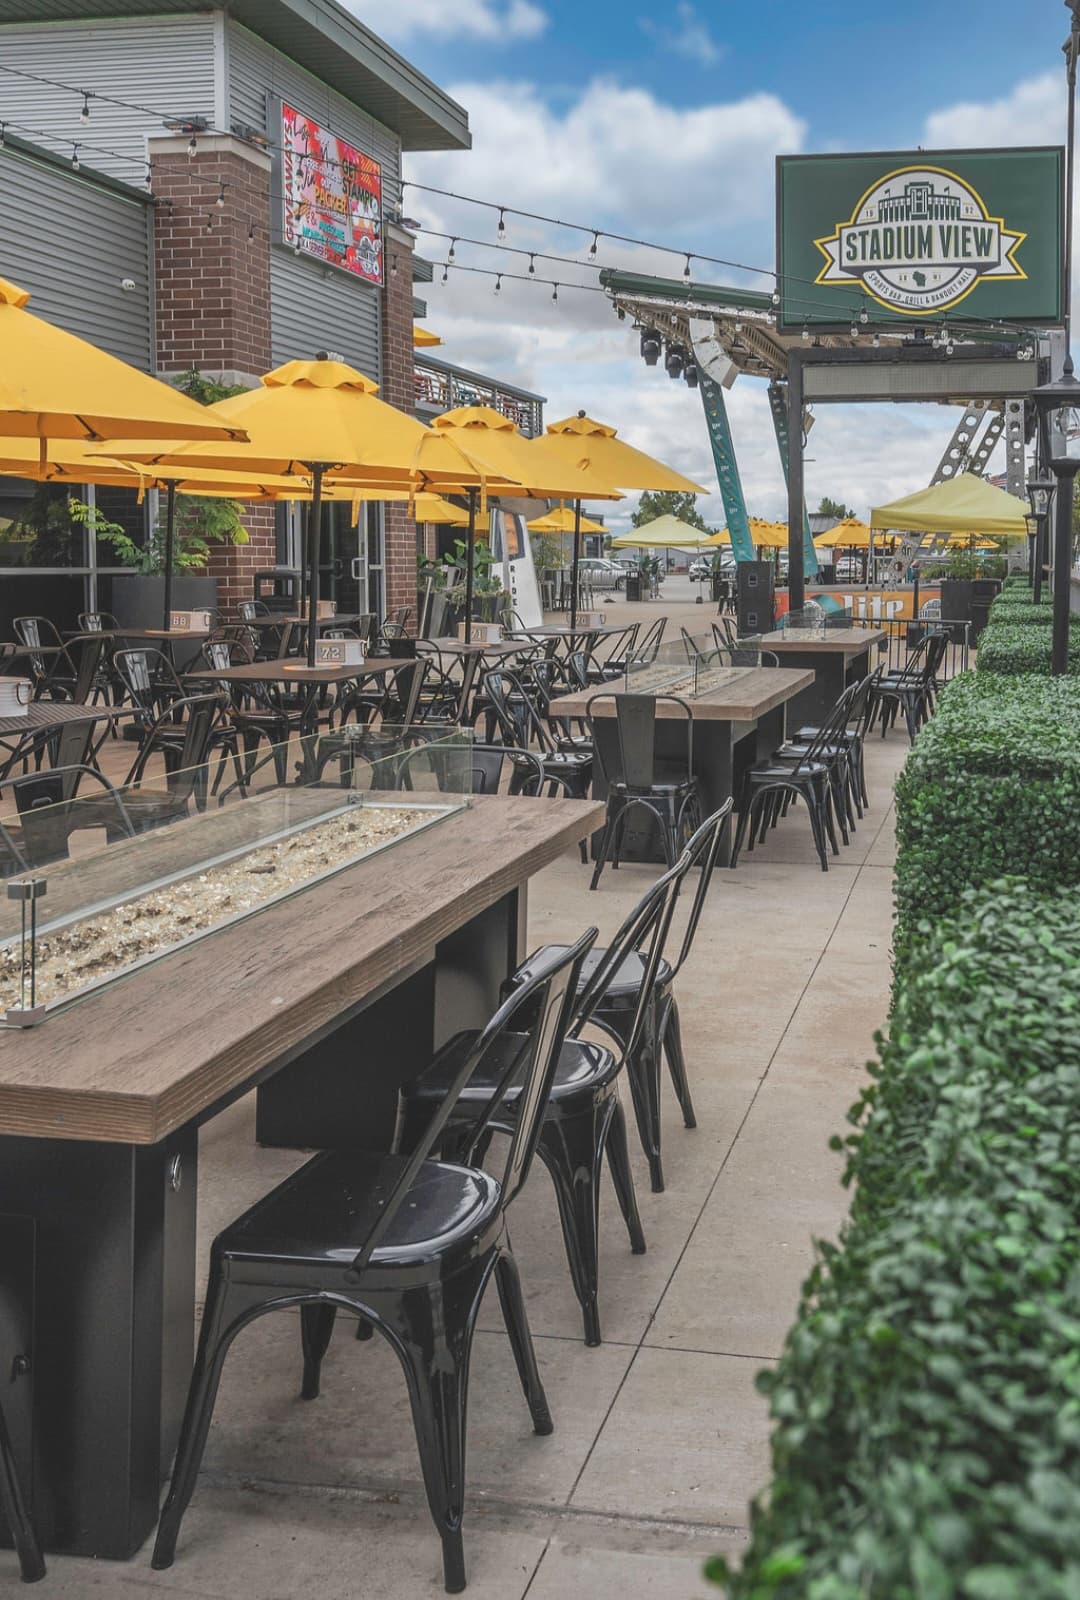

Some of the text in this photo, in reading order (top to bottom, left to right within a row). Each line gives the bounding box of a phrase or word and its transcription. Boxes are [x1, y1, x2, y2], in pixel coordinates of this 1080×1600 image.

[846, 224, 994, 262] STADIUM VIEW
[868, 273, 889, 295] SPORTS
[931, 283, 959, 302] BANQUET
[957, 271, 972, 286] HALL
[509, 565, 518, 606] RIDE
[321, 647, 340, 660] 72
